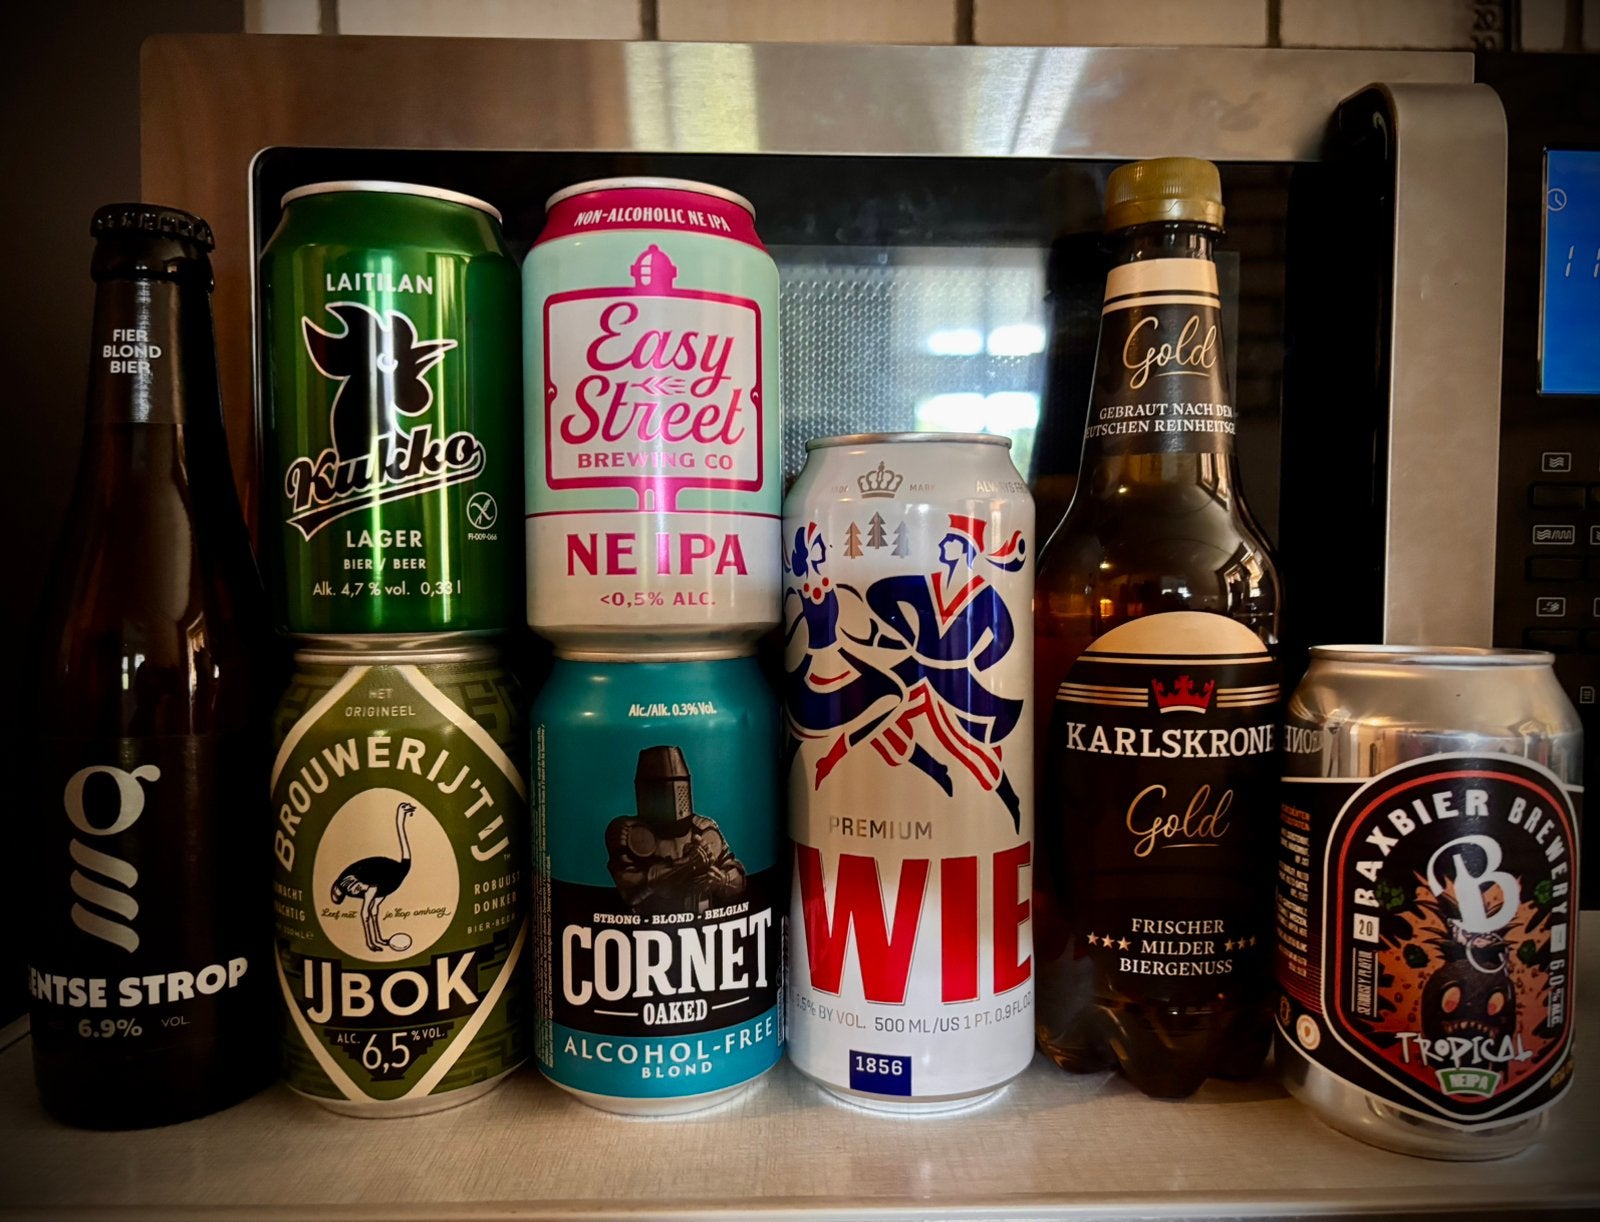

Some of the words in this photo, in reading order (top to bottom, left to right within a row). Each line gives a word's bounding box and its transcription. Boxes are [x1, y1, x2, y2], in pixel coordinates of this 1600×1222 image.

[574, 207, 685, 227] NON-ALCOHOLIC
[688, 211, 707, 229] NE
[709, 213, 731, 232] IPA
[326, 272, 433, 295] LAITILAN
[113, 329, 148, 342] FIER
[103, 345, 162, 359] BLOND
[586, 301, 736, 398] Easy
[1122, 315, 1217, 390] Gold
[110, 361, 151, 374] BIER
[560, 374, 745, 445] Street
[1100, 403, 1169, 420] GEBRAUT
[1172, 402, 1213, 416] NACH
[285, 423, 486, 514] Kukko
[578, 452, 696, 469] BREWING
[705, 454, 734, 470] CO
[346, 530, 423, 548] LAGER
[343, 558, 373, 570] BIER
[393, 558, 427, 570] BEER
[566, 532, 637, 576] NE
[656, 532, 748, 576] IPA
[312, 581, 336, 596] Alk.
[341, 583, 364, 598] 4,7
[384, 580, 411, 596] vol.
[420, 582, 453, 598] 0,33
[673, 592, 716, 606] ALC.
[368, 688, 393, 700] HET
[345, 705, 417, 718] ORIGINEEL
[672, 702, 698, 716] 0.3%
[698, 701, 717, 715] Vol.
[1066, 721, 1275, 758] KARLSKRONE
[829, 816, 933, 840] PREMIUM
[1126, 784, 1234, 857] Gold
[1354, 789, 1489, 909] BRAXBIER
[1507, 796, 1569, 915] BREWERY
[474, 870, 521, 896] ROBUUST
[474, 891, 517, 915] DONKER
[593, 912, 641, 925] STRONG
[652, 912, 694, 925] BLOND
[704, 901, 749, 921] BELGIAN
[1131, 918, 1225, 935] FRISCHER
[1358, 918, 1374, 936] 20
[562, 907, 772, 1006] CORNET
[1140, 939, 1215, 955] MILDER
[1119, 957, 1233, 976] BIERGENUSS
[29, 966, 107, 1008] ENTSE
[118, 957, 248, 1008] STROP
[303, 950, 479, 1024] IJBOK
[643, 999, 708, 1026] OAKED
[818, 1005, 834, 1022] BY
[836, 1009, 866, 1029] VOL.
[874, 1016, 905, 1033] 500
[964, 1015, 971, 1030] 1
[974, 1010, 992, 1028] PT.
[78, 1018, 143, 1038] 6.9%
[337, 1032, 360, 1044] ALC.
[362, 1031, 410, 1074] 6,5
[564, 1015, 773, 1066] ALCOHOL-FREE
[1394, 1031, 1534, 1070] TROPICAL
[641, 1061, 713, 1079] BLOND
[855, 1055, 903, 1076] 1856
